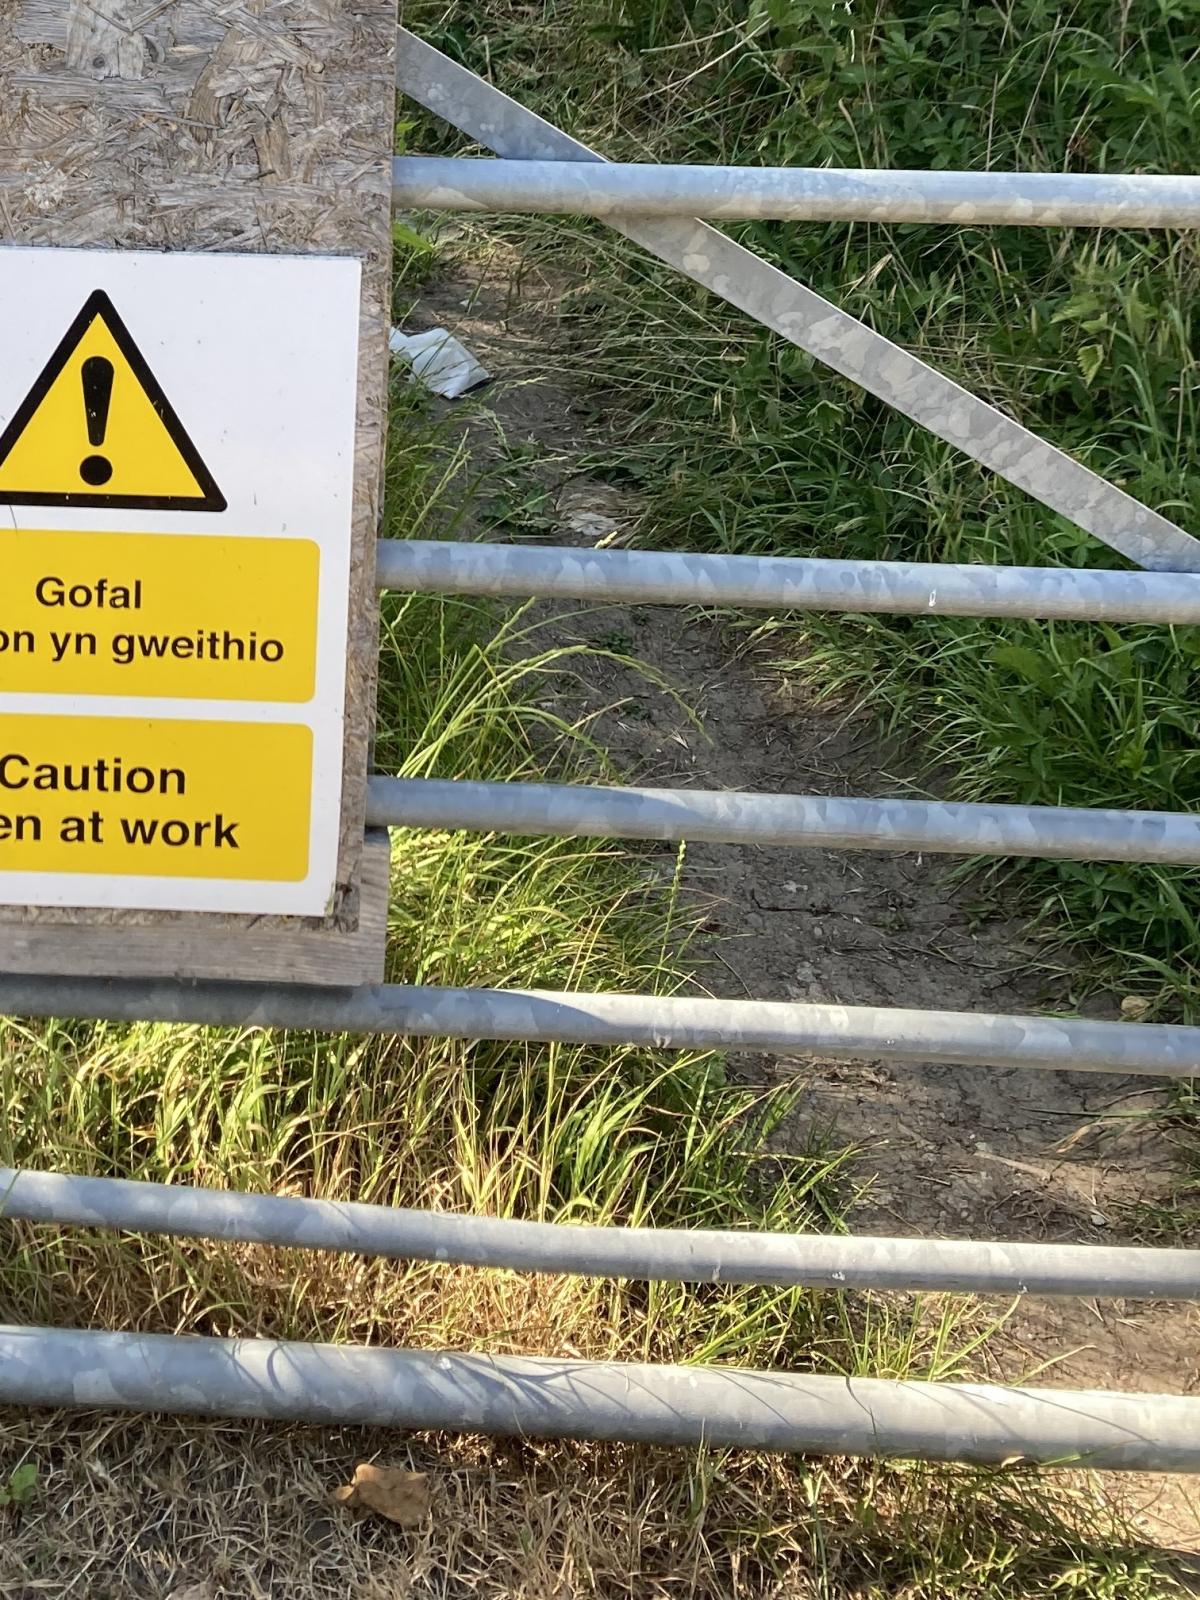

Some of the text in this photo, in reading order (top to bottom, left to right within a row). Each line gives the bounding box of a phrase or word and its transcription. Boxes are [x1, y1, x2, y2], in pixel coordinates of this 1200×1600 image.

[35, 576, 141, 609] Gofal
[50, 632, 96, 662] yn
[112, 631, 284, 665] gweithio
[60, 811, 104, 843] at
[120, 814, 239, 848] work
